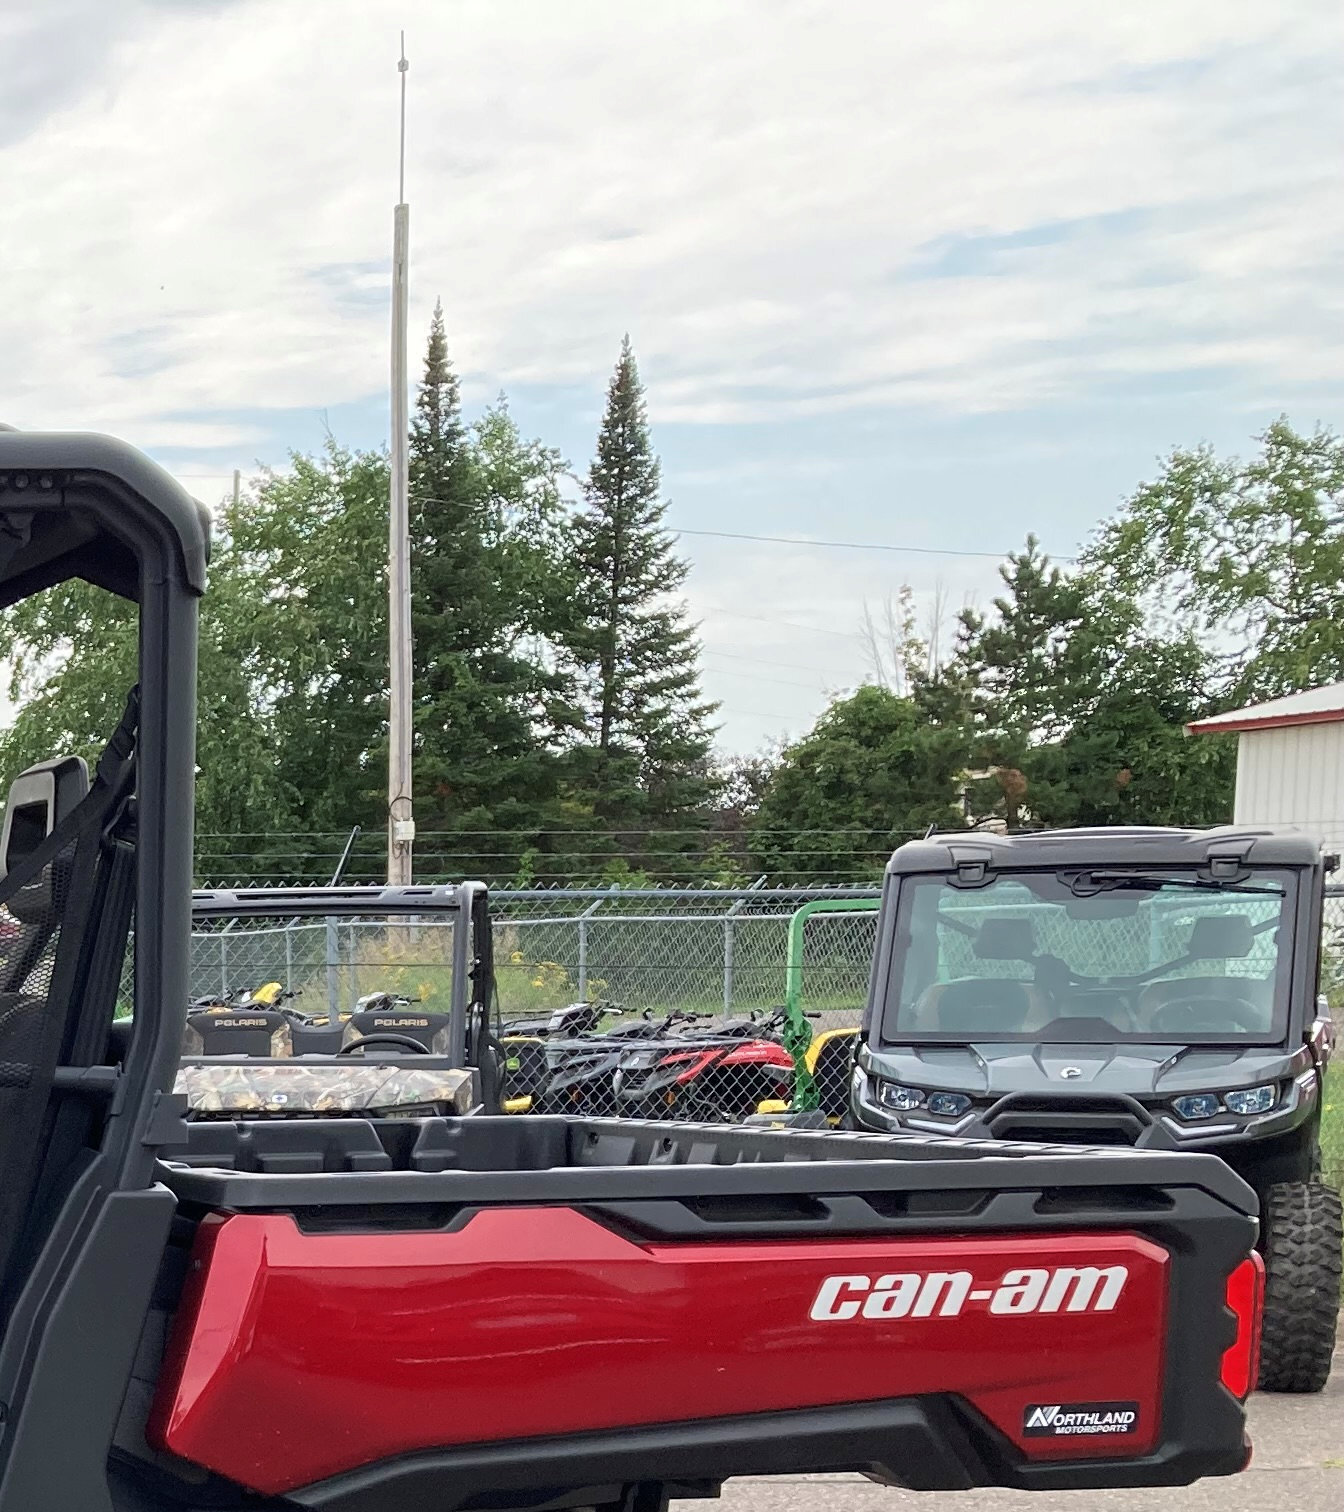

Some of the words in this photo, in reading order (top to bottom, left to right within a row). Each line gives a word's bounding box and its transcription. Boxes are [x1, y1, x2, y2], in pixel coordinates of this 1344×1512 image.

[215, 1018, 268, 1027] POLARIS
[374, 1018, 428, 1027] POLARIS
[1026, 1405, 1135, 1427] NORTHLAND
[1056, 1424, 1128, 1434] MOTORSPORTS
